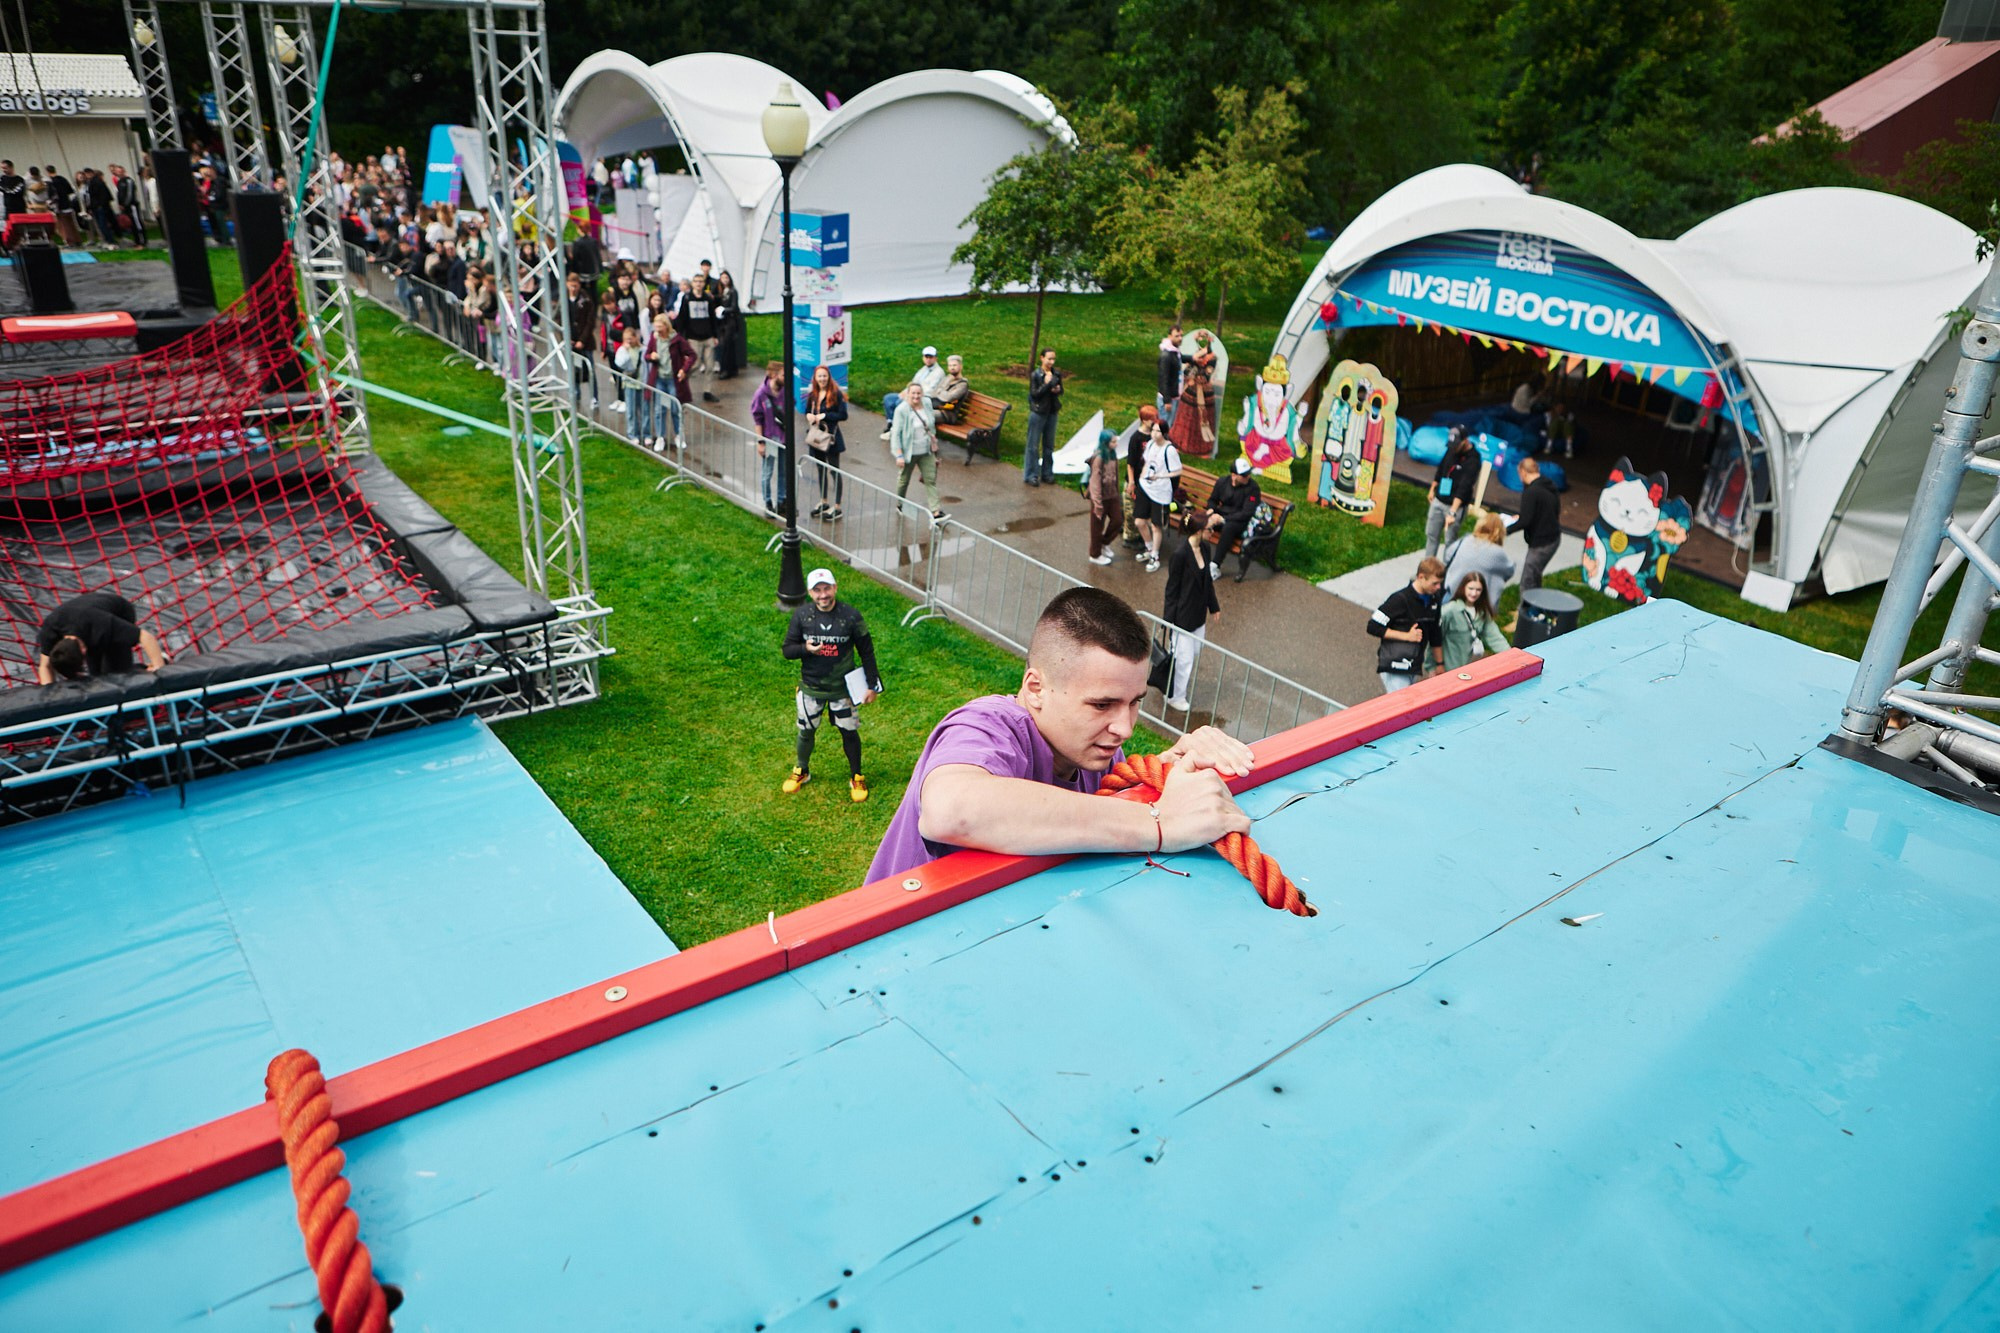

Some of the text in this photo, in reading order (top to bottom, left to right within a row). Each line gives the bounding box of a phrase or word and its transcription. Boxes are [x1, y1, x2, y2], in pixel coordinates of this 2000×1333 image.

[1496, 255, 1554, 276] МОСКВА
[1387, 269, 1661, 347] МУЗЕЙ ВОСТОКА
